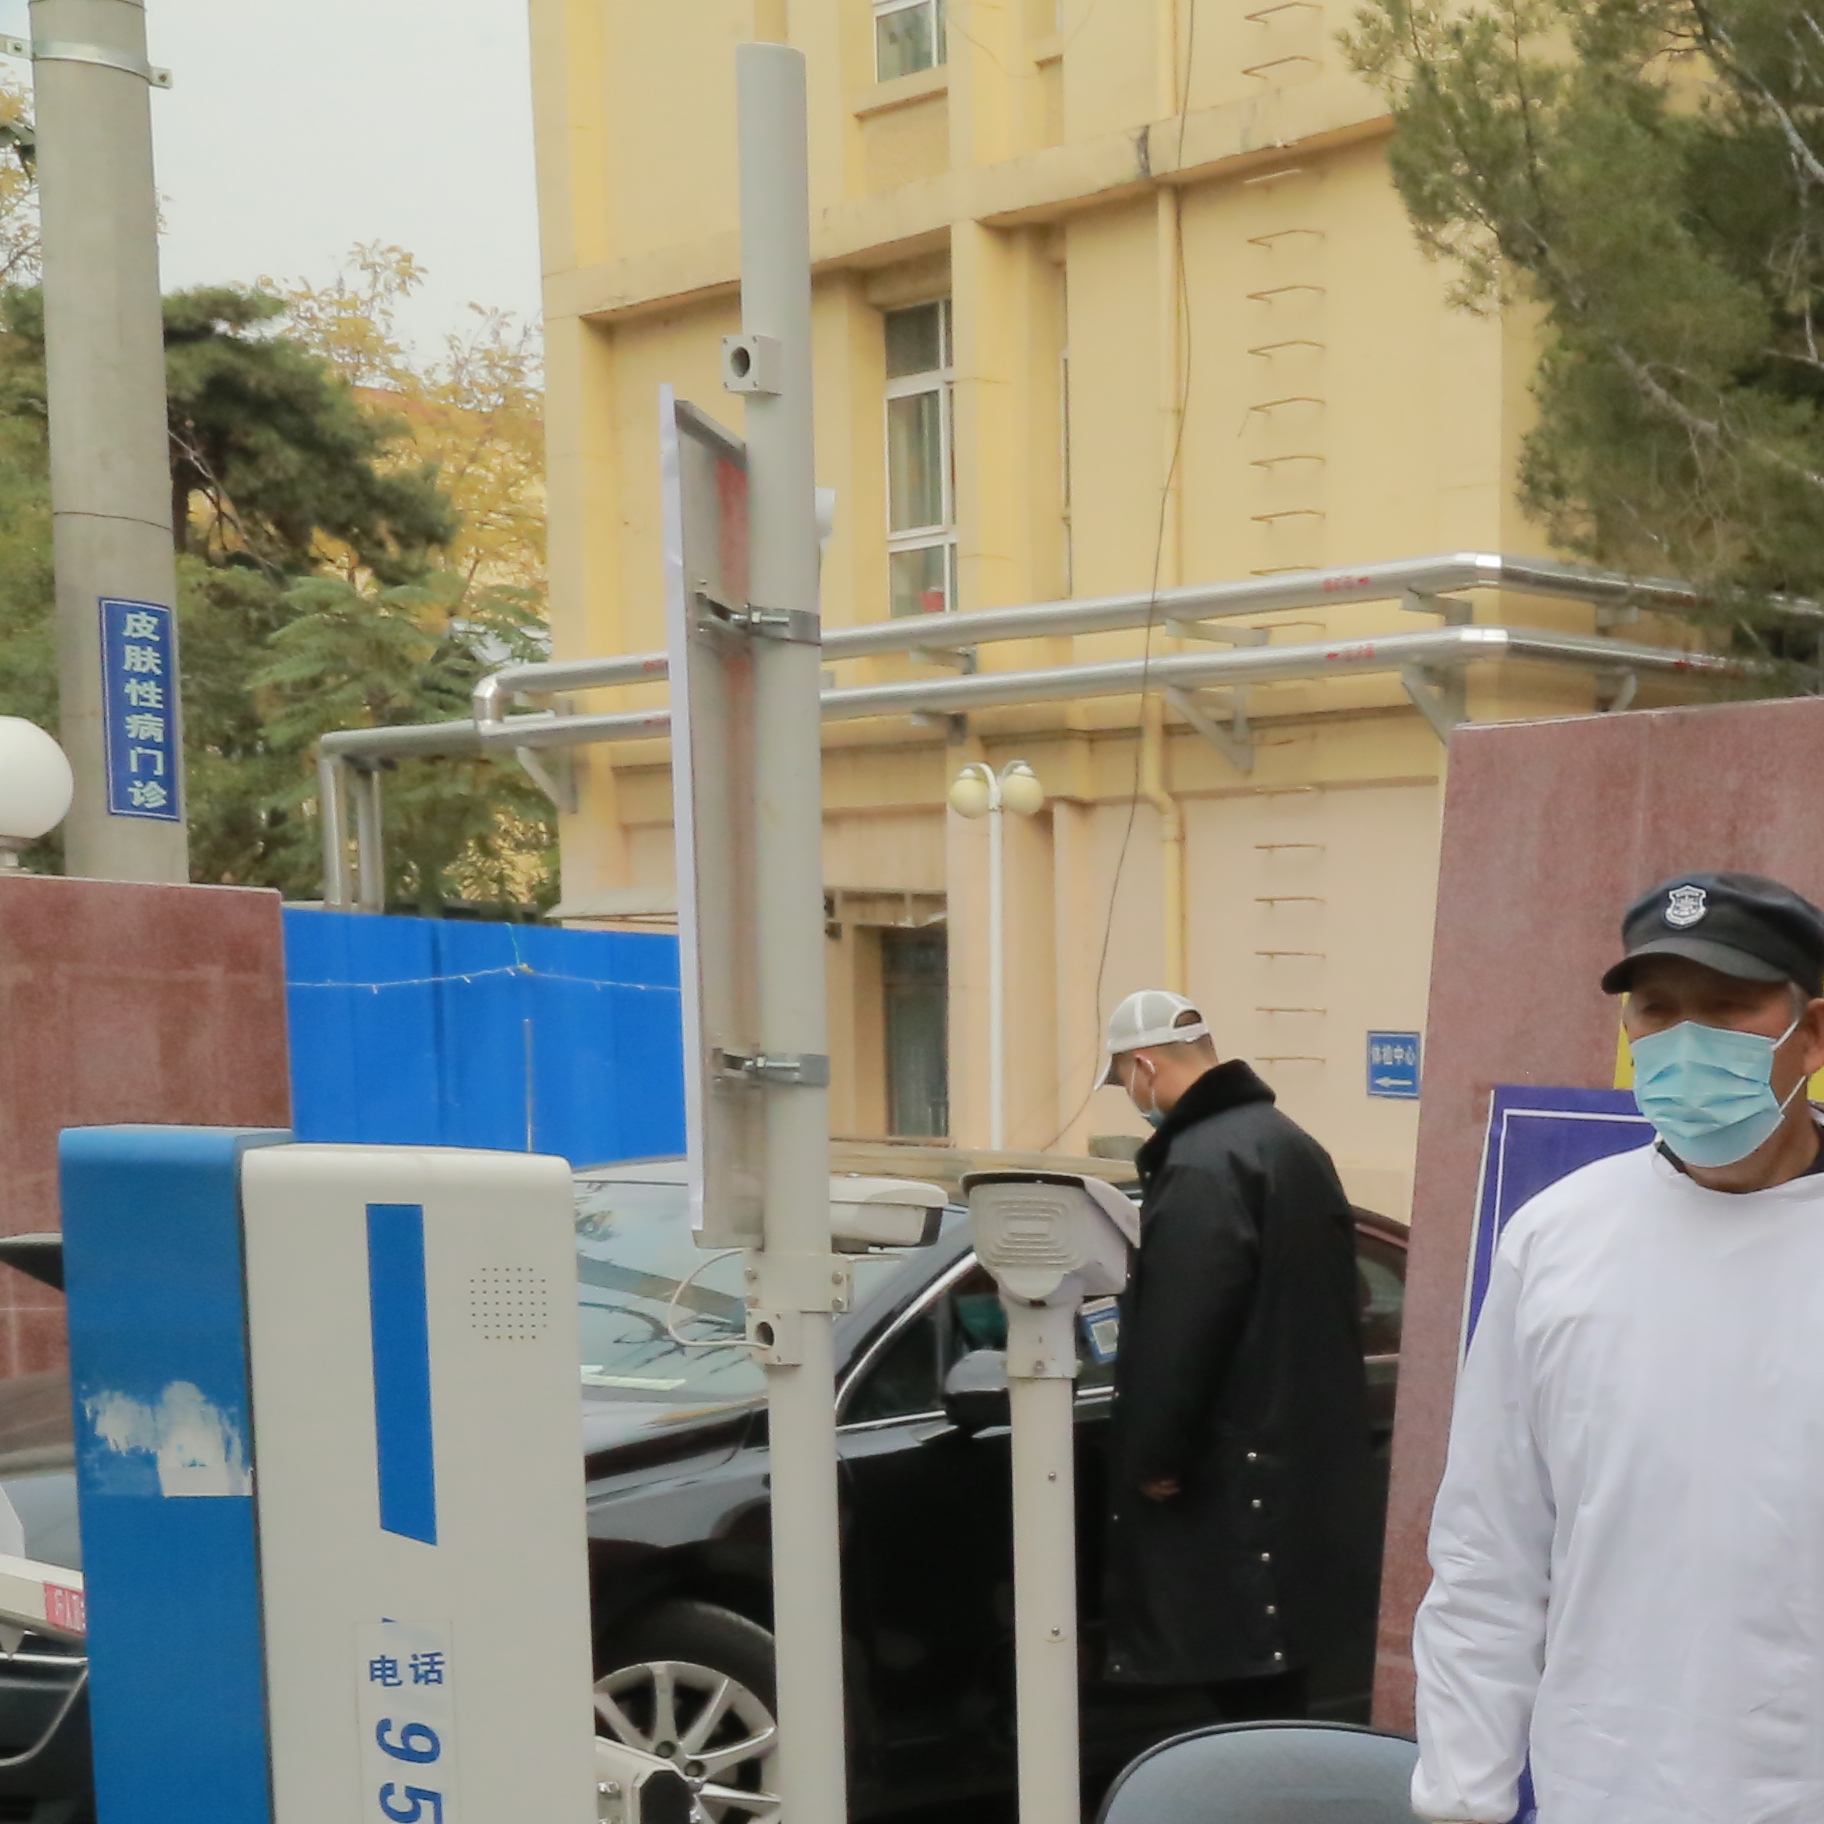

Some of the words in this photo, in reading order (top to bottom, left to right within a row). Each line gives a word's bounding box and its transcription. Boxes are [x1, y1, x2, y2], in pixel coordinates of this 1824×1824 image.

[122, 611, 168, 809] 皮肤性病门诊
[367, 1650, 446, 1688] 电话
